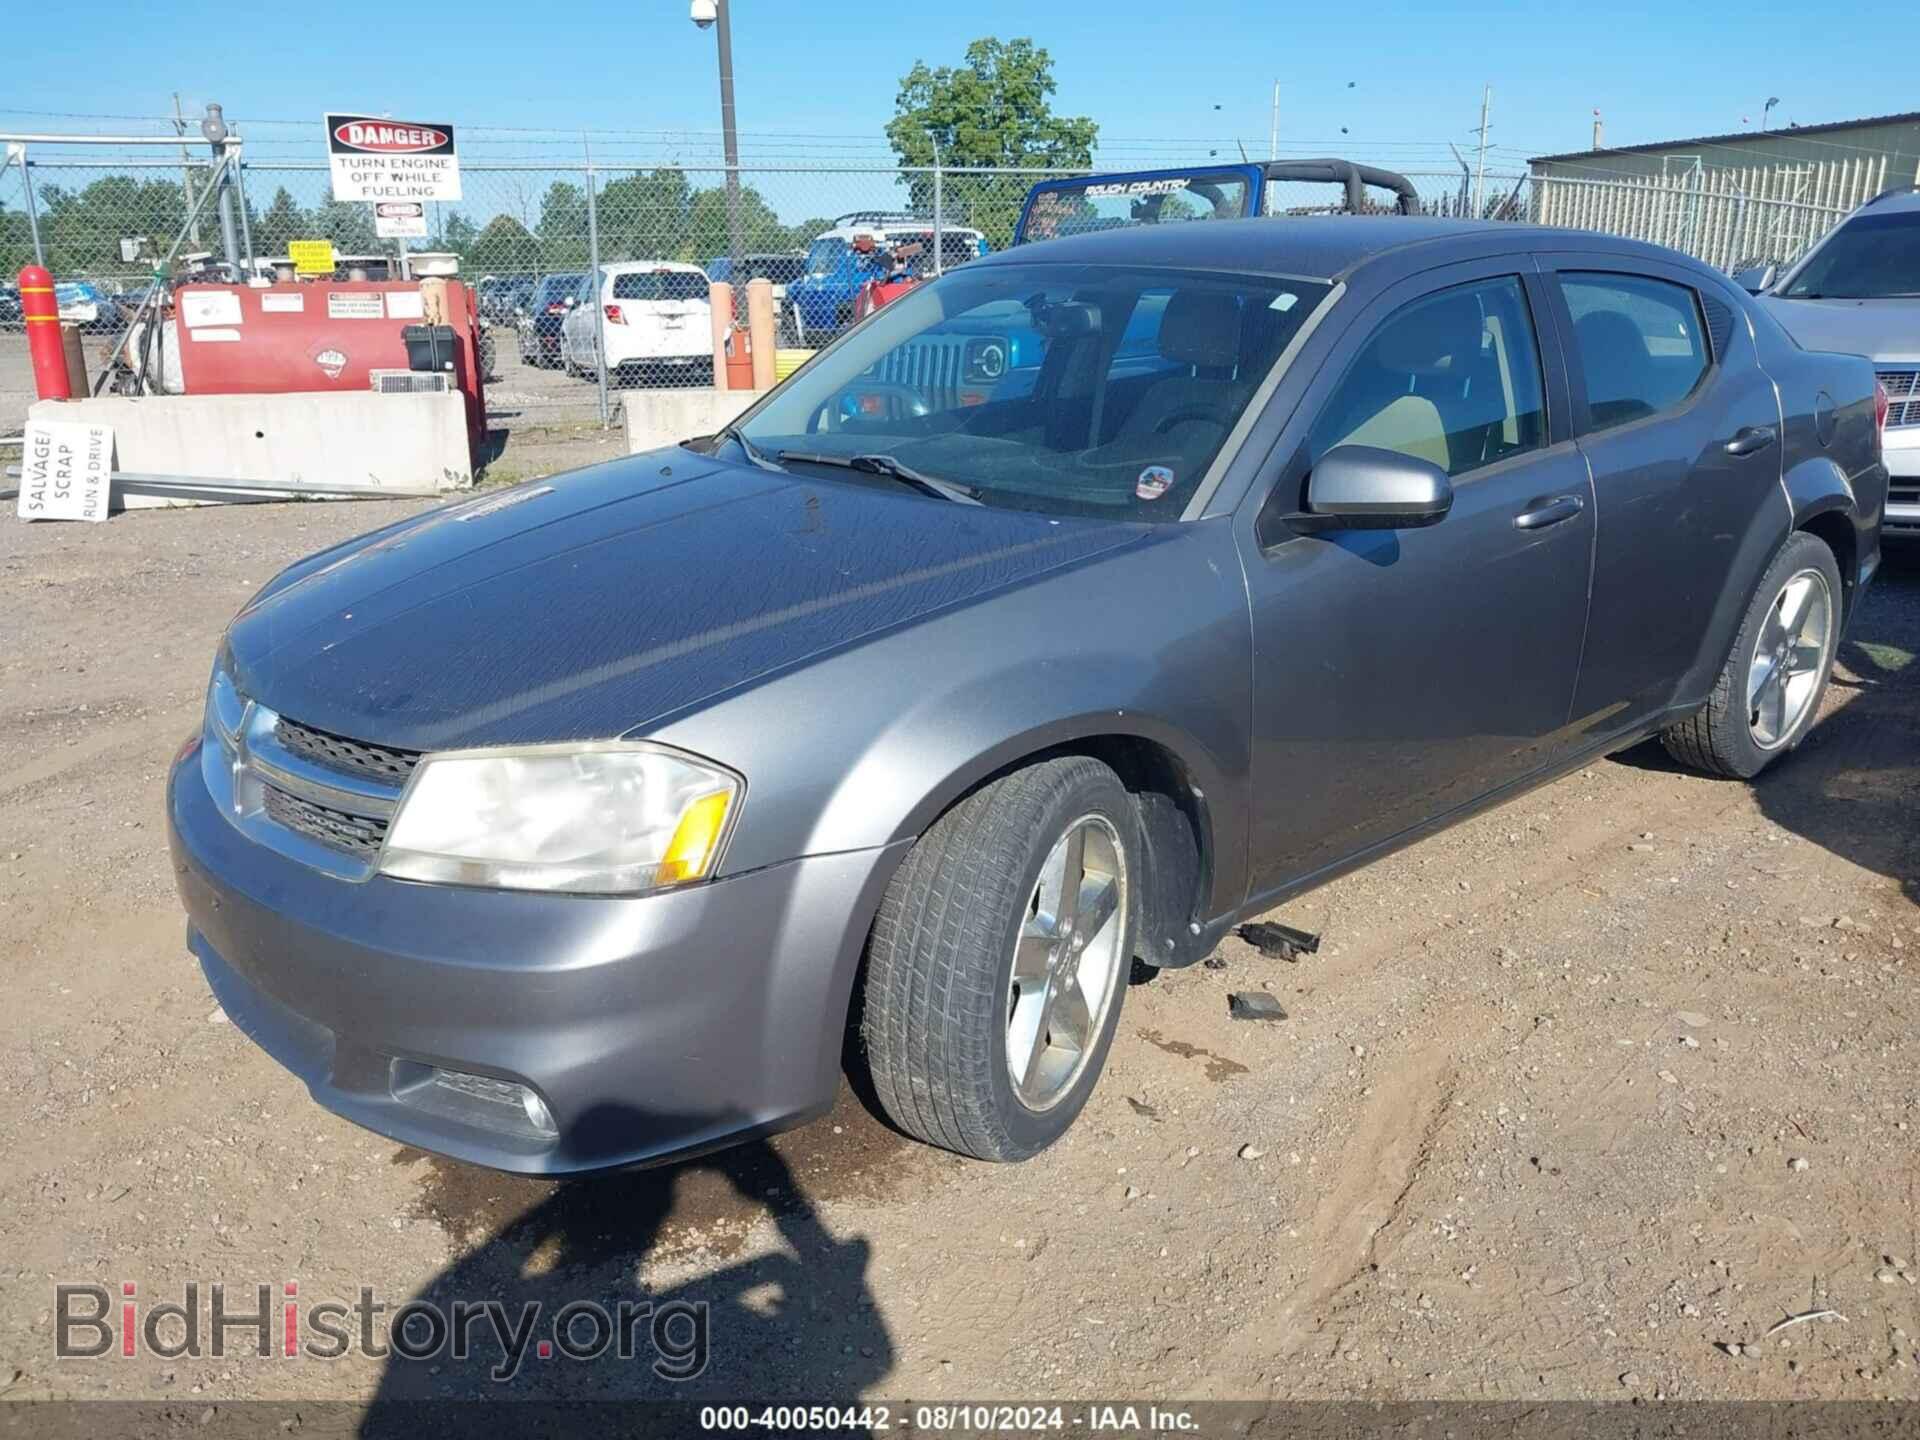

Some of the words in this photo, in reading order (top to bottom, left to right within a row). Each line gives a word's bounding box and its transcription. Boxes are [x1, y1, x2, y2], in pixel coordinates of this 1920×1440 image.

[349, 125, 436, 145] DANGER
[339, 158, 385, 169] TURN
[391, 159, 449, 169] ENGINE
[351, 172, 383, 183] OFF
[391, 173, 442, 183] WHILE
[1083, 184, 1127, 195] ROUGH
[1130, 178, 1191, 193] COUNTRY
[362, 186, 435, 196] FUELING
[88, 428, 103, 471] DRIVE
[28, 430, 51, 511] SALVAGE/
[54, 445, 72, 499] SCRAP
[86, 475, 99, 485] &
[83, 489, 98, 517] RUN
